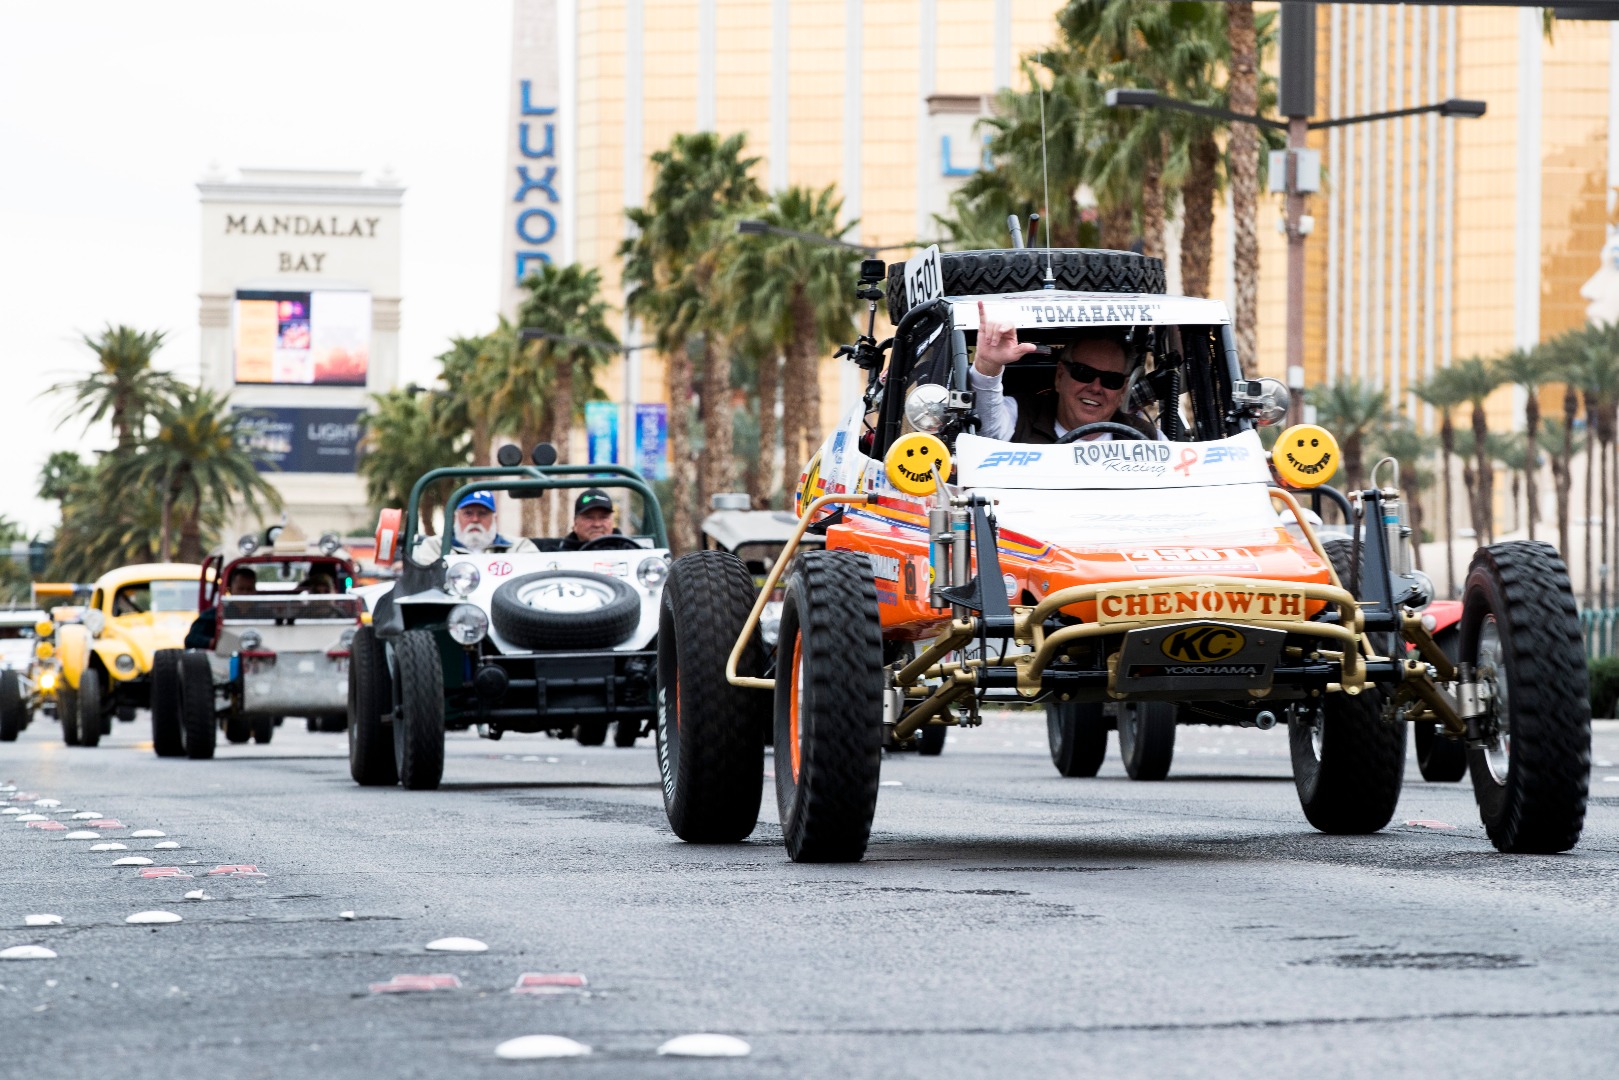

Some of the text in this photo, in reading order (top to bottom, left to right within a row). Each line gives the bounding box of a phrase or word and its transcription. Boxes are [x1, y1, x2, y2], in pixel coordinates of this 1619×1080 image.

[225, 215, 381, 238] MANDALAY
[278, 252, 327, 272] BAY
[1073, 443, 1171, 466] ROWLAND
[1102, 458, 1167, 477] Racing
[1131, 548, 1243, 562] 4501
[1101, 591, 1301, 618] CHENOWTH
[1169, 627, 1237, 661] KC
[1164, 666, 1258, 675] YOKOHAMA
[658, 686, 675, 799] YOKOHAMA
